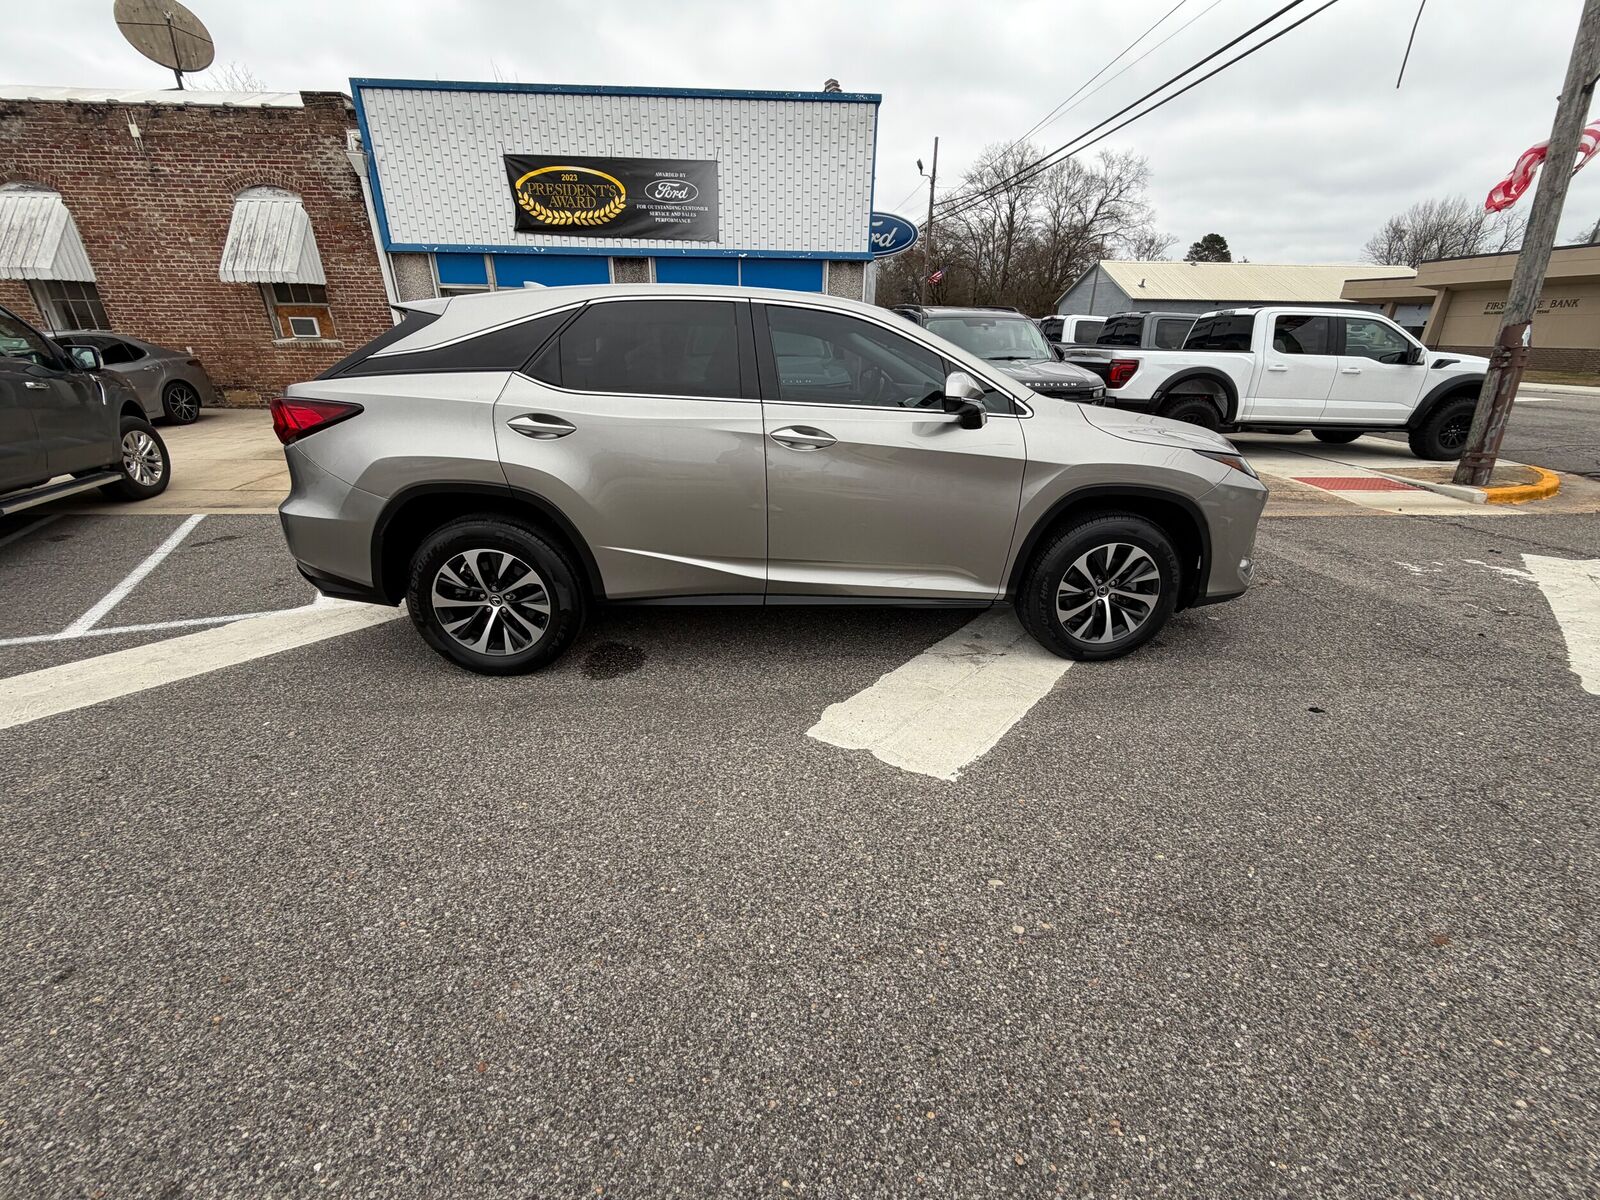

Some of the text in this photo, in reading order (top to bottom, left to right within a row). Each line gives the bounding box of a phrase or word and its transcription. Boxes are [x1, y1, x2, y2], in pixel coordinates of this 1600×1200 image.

[561, 173, 578, 182] 2023
[526, 182, 617, 197] PRESIDENT'S
[654, 182, 689, 199] Ford
[548, 195, 597, 209] AWARD
[871, 221, 898, 248] rd
[1550, 299, 1579, 309] BANK
